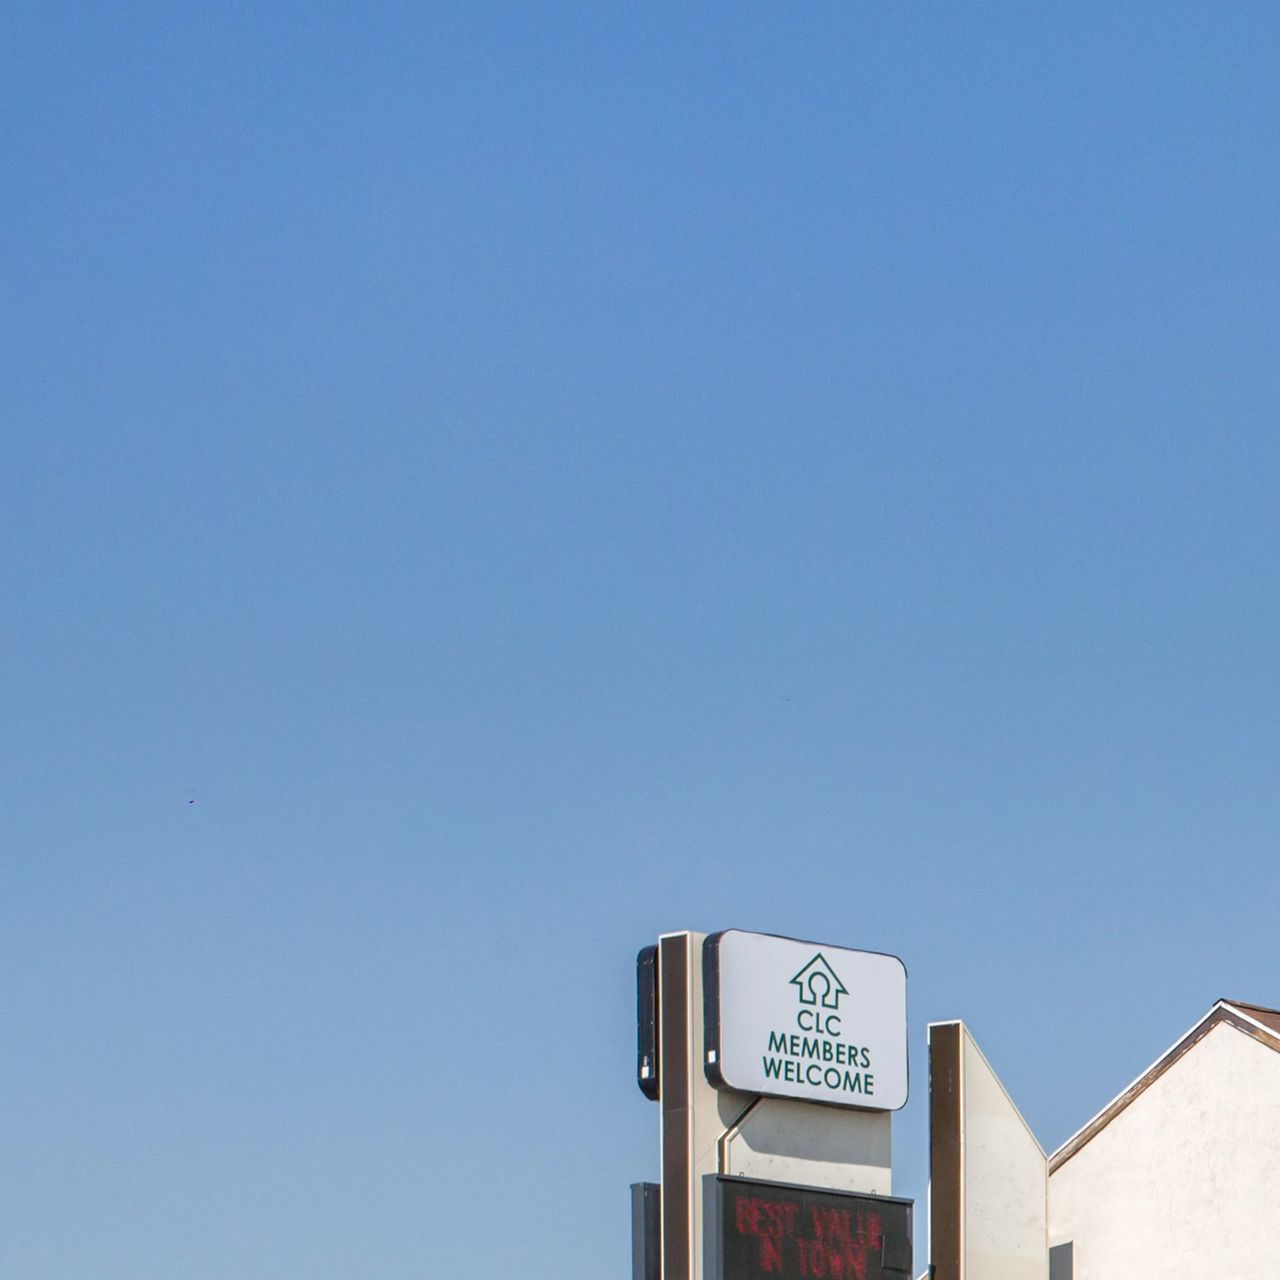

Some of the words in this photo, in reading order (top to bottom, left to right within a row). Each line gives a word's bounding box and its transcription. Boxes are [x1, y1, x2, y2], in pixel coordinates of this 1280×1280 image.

[797, 1009, 841, 1037] CLC
[768, 1030, 871, 1069] MEMBERS
[762, 1056, 874, 1096] WELCOME
[735, 1195, 798, 1240] BEST
